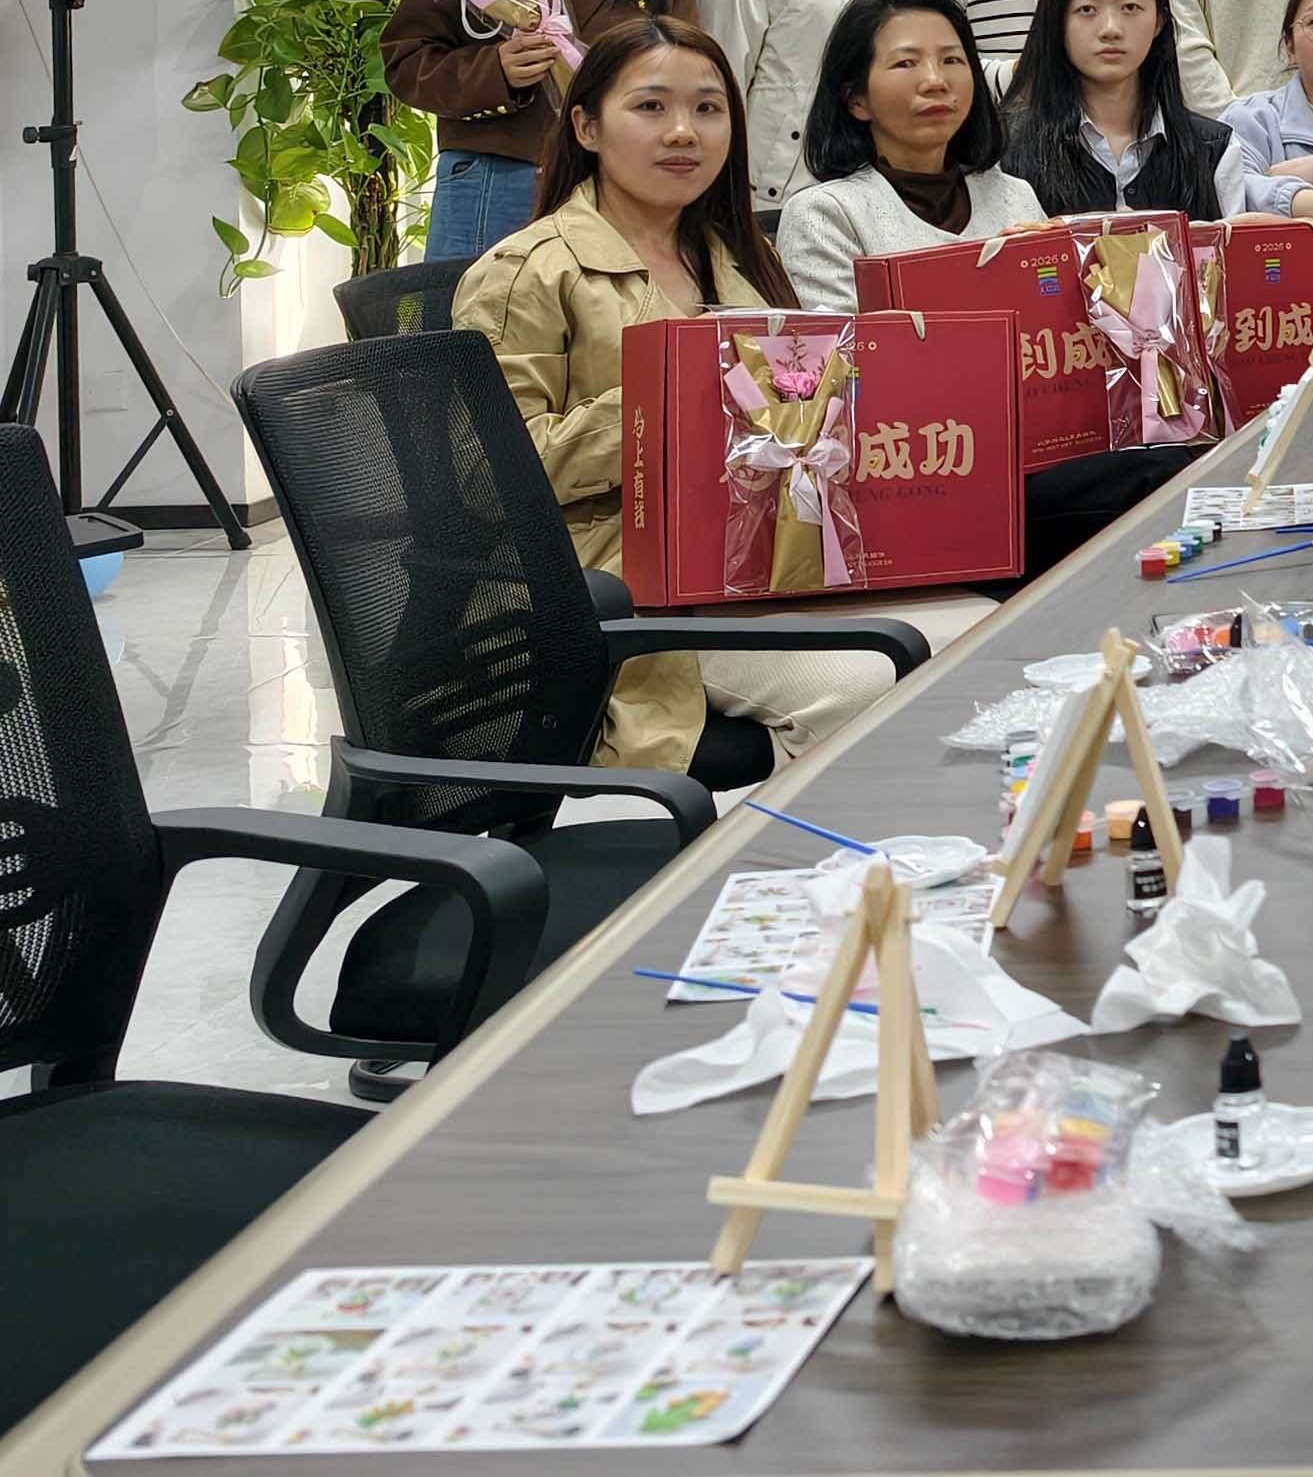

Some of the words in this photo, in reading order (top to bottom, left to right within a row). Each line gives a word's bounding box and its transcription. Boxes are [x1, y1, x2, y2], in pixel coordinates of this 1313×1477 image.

[1030, 254, 1059, 267] 2026
[1021, 322, 1112, 381] 到成
[831, 419, 975, 484] 成功
